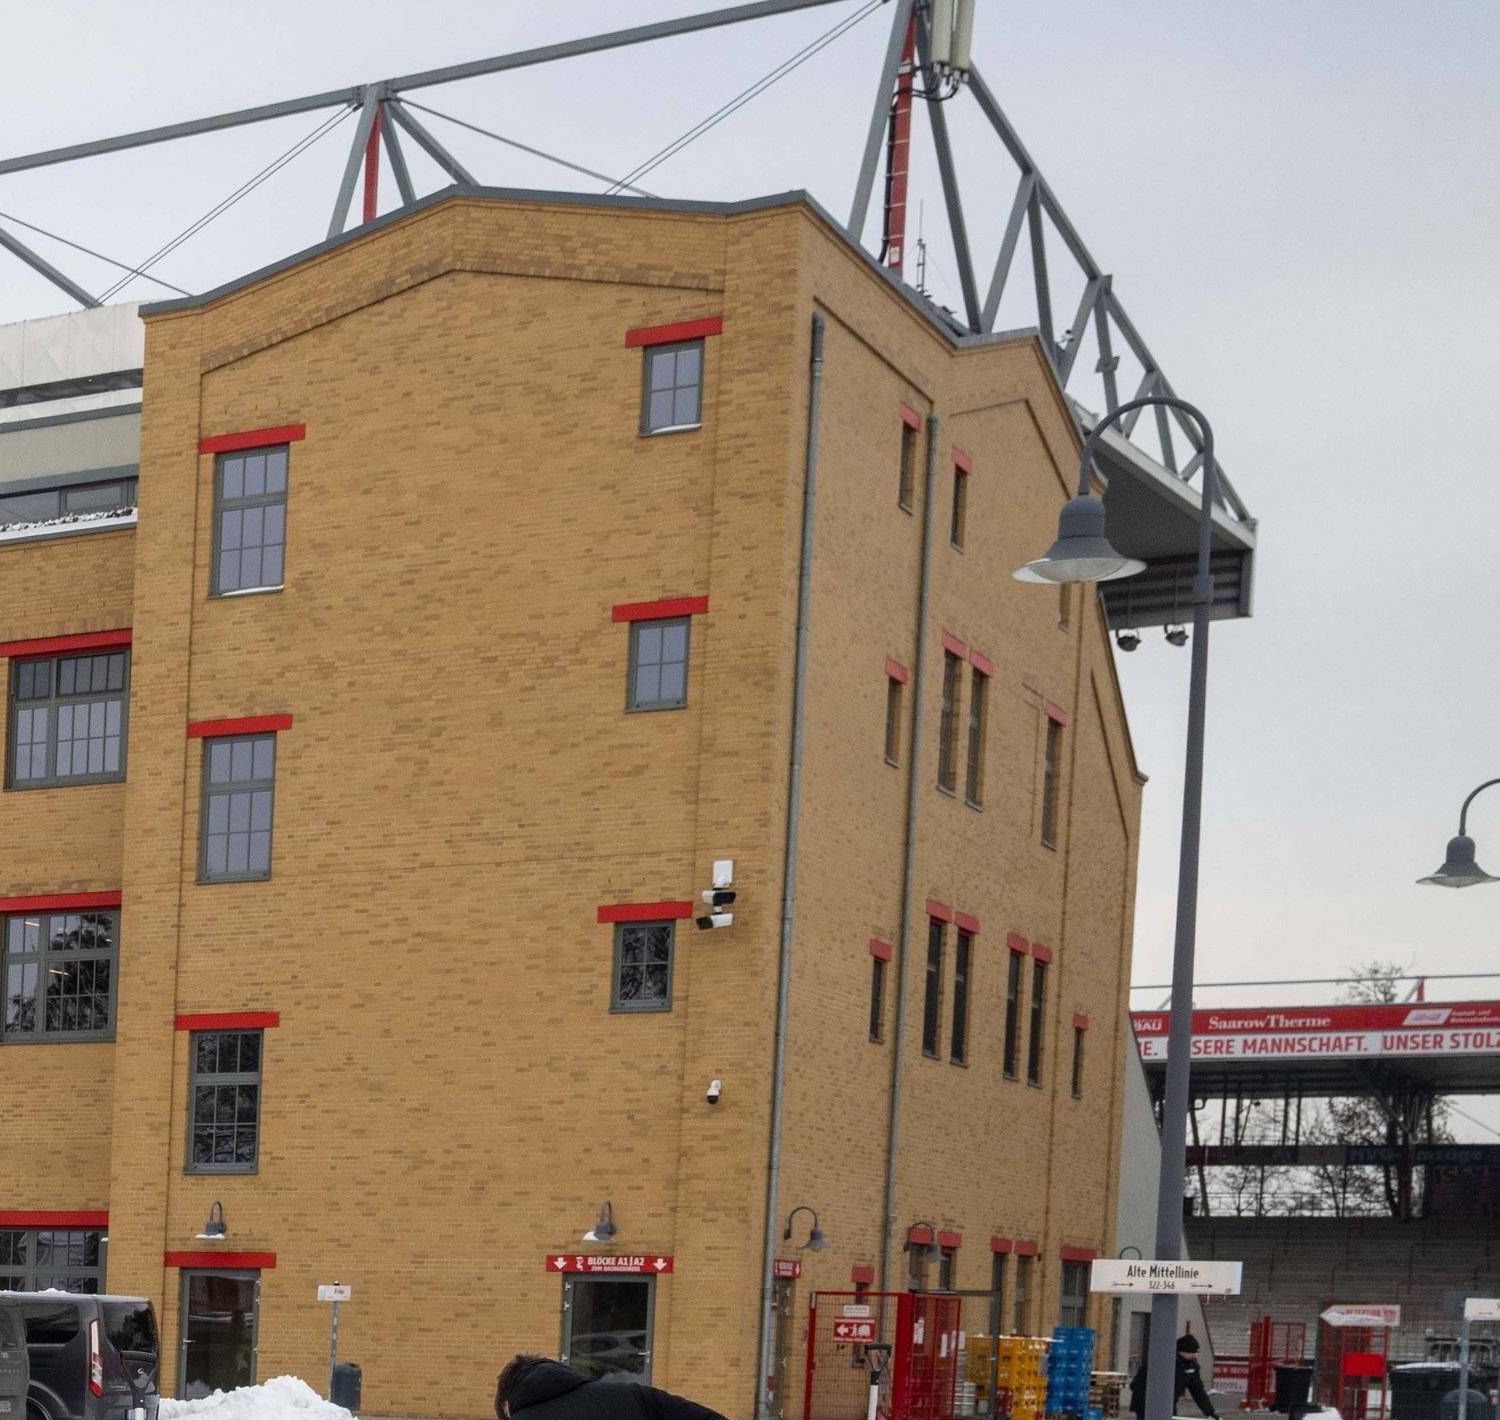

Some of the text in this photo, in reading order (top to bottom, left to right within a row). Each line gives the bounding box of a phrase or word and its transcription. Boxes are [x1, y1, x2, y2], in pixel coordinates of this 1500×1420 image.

[1208, 1013, 1331, 1031] SaarowTherme
[1242, 1035, 1368, 1055] MANNSCHAFT.
[1383, 1033, 1444, 1051] UNSER
[1127, 1265, 1200, 1279] Alte Mittellinie
